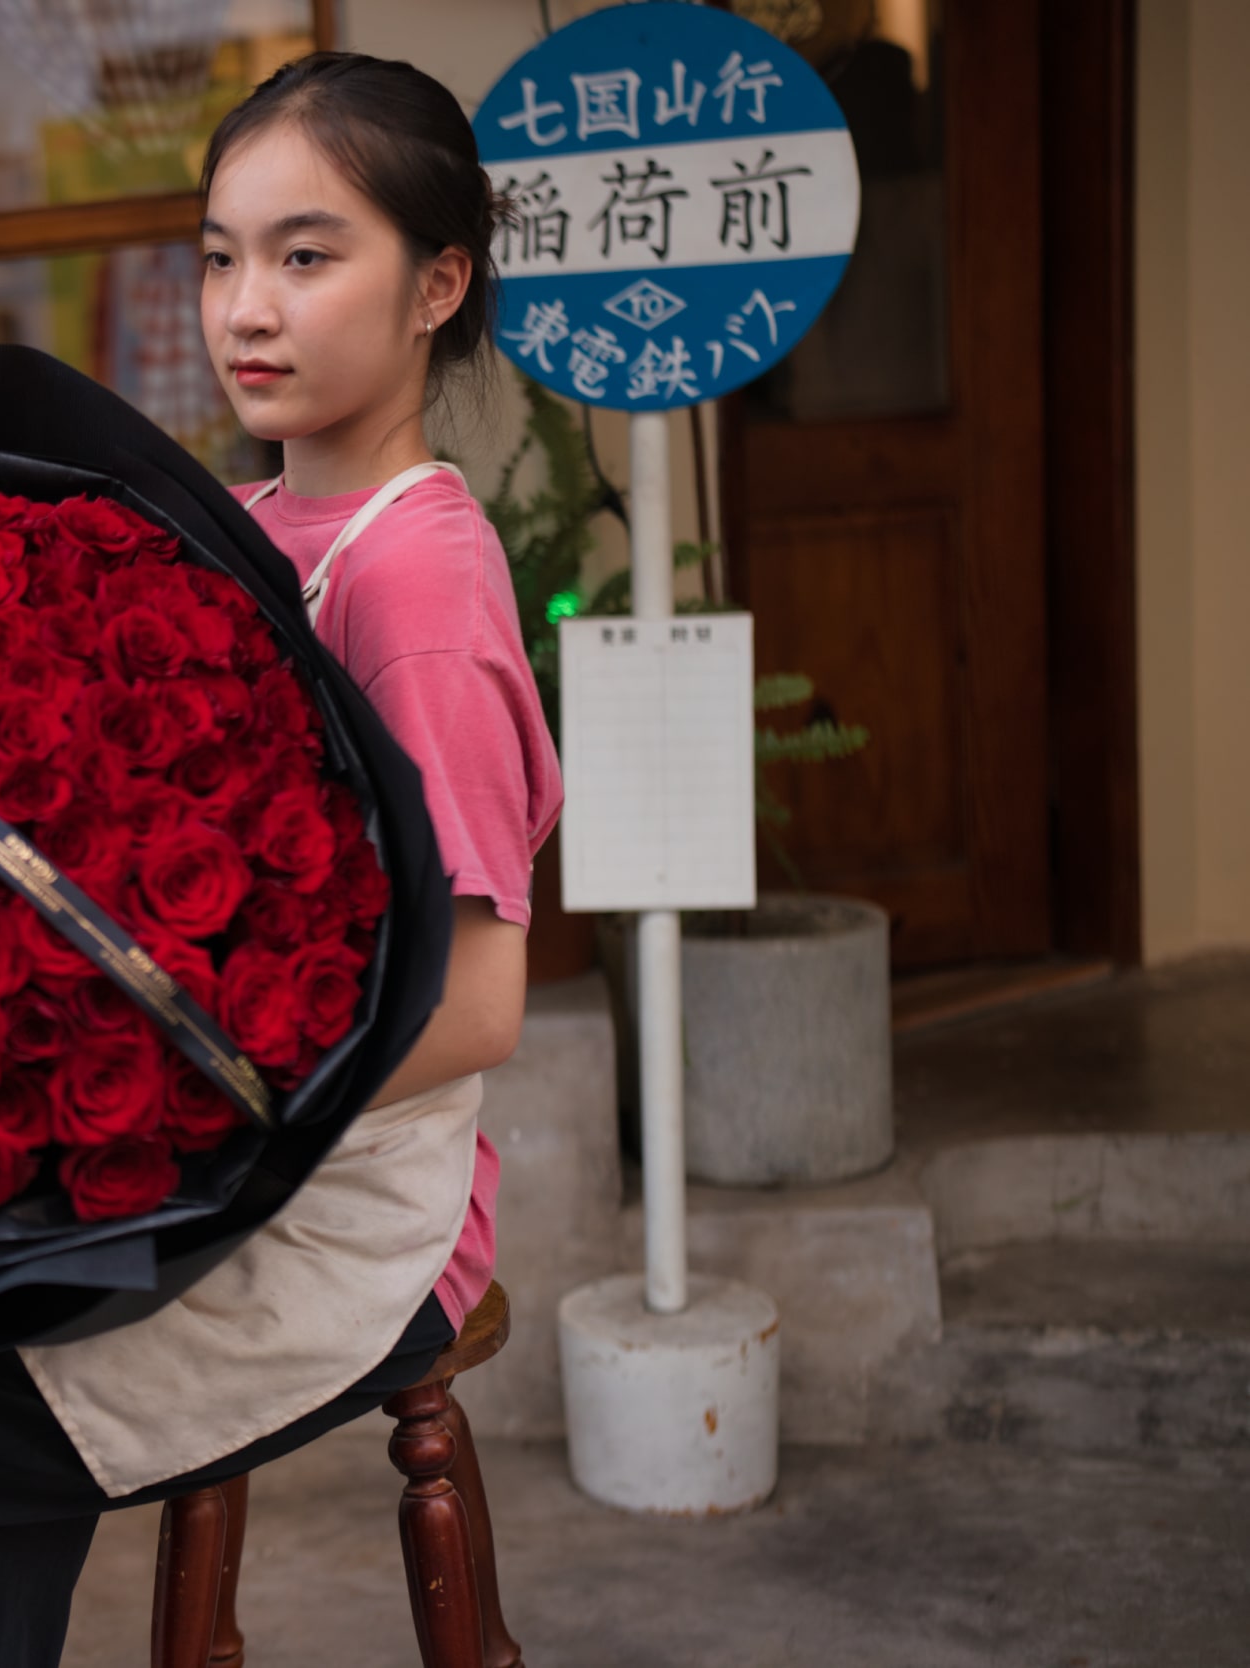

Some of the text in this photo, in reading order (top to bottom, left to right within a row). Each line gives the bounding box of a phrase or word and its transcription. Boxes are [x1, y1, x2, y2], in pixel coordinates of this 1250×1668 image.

[498, 51, 783, 147] 七国山行
[497, 149, 813, 266] 稲荷前
